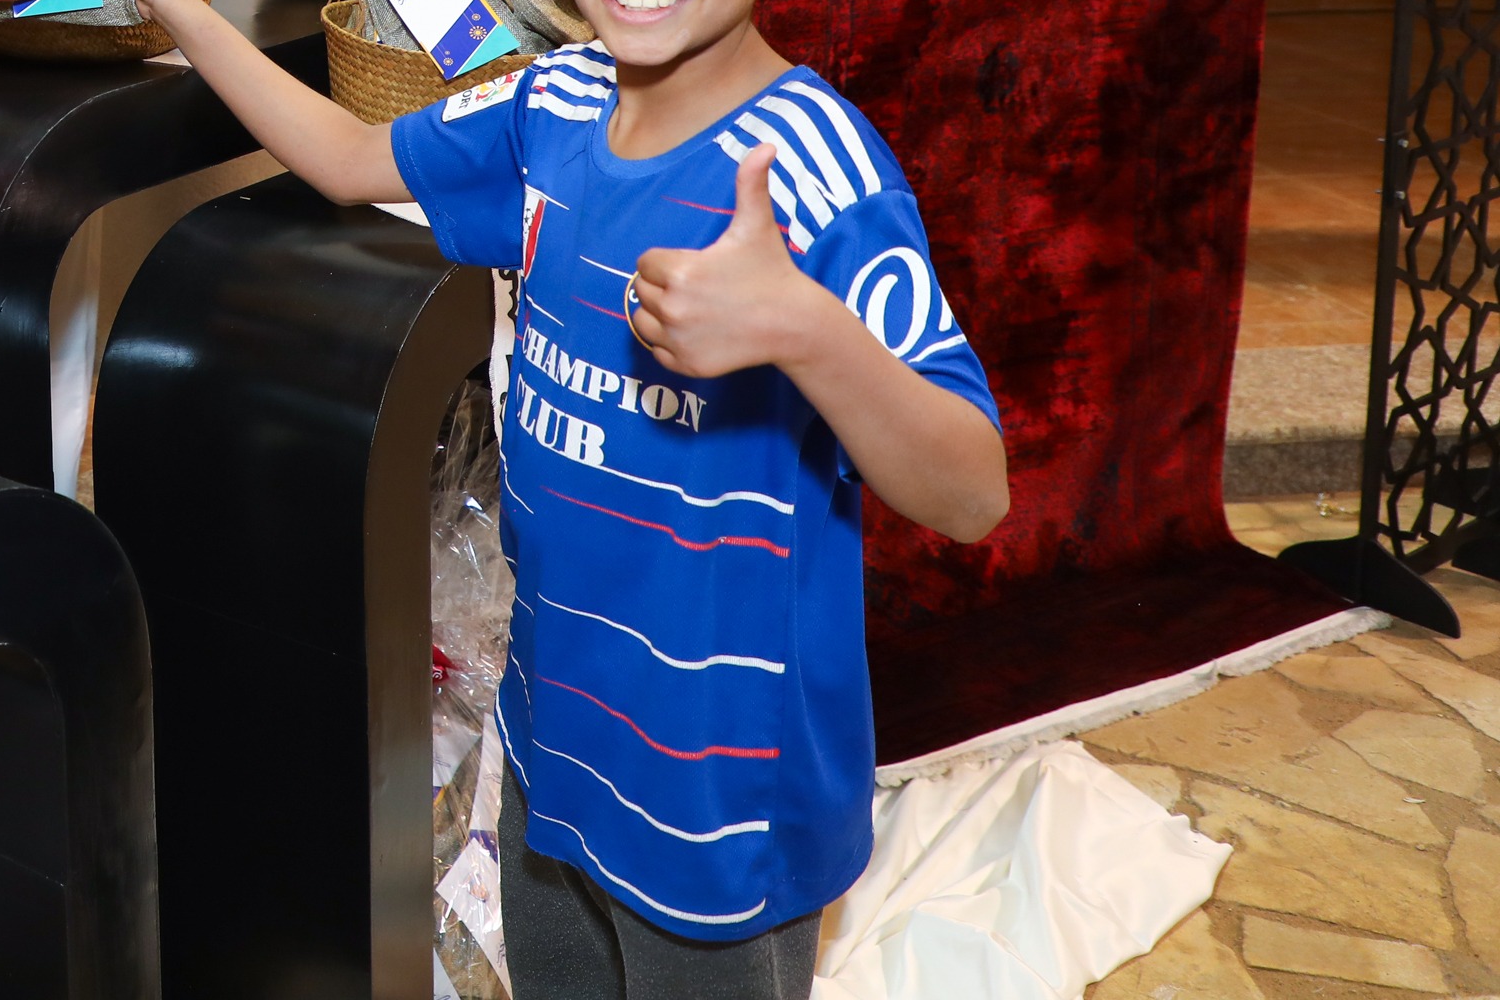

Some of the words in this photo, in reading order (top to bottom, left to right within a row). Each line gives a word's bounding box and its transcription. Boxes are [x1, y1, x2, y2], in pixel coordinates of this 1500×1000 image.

[459, 89, 473, 109] ORT
[517, 373, 606, 467] CLUB
[523, 322, 707, 433] CHAMPION
